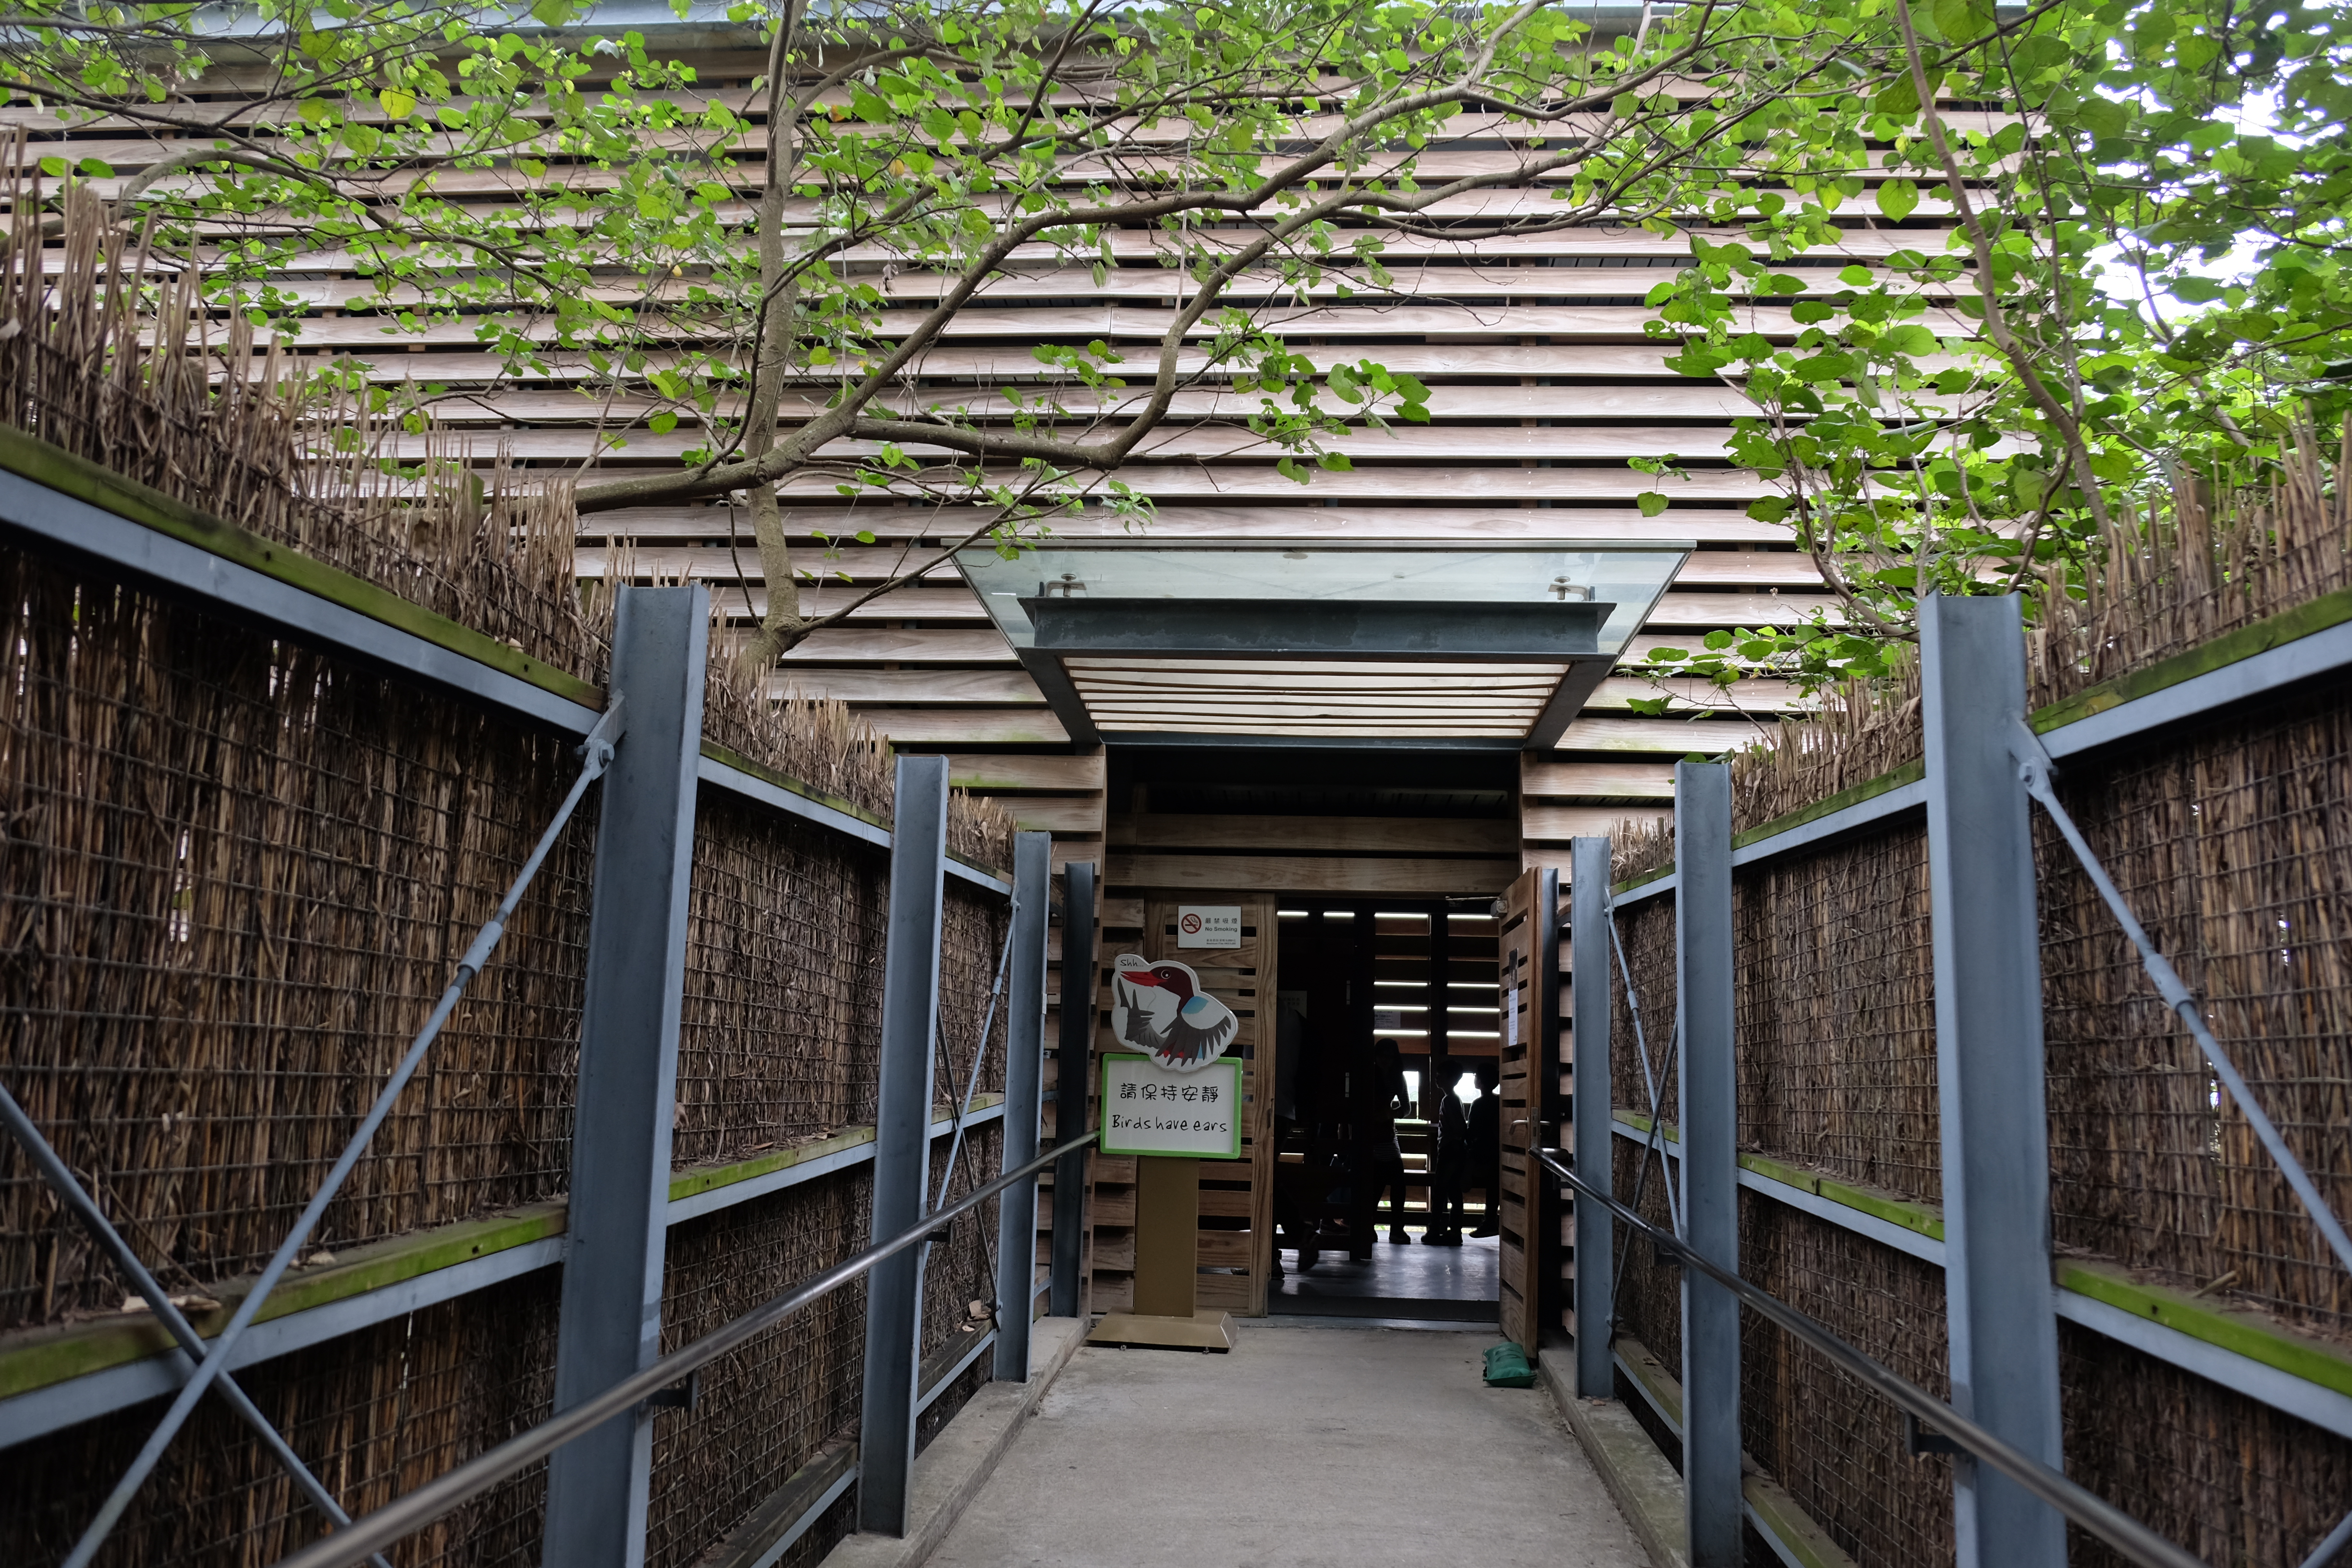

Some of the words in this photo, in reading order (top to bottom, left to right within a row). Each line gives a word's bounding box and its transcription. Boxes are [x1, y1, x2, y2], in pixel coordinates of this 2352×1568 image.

[1120, 1083, 1218, 1102] 請保持安靜
[1112, 1115, 1151, 1129] Birds
[1156, 1116, 1188, 1131] have
[1193, 1120, 1227, 1132] ears
